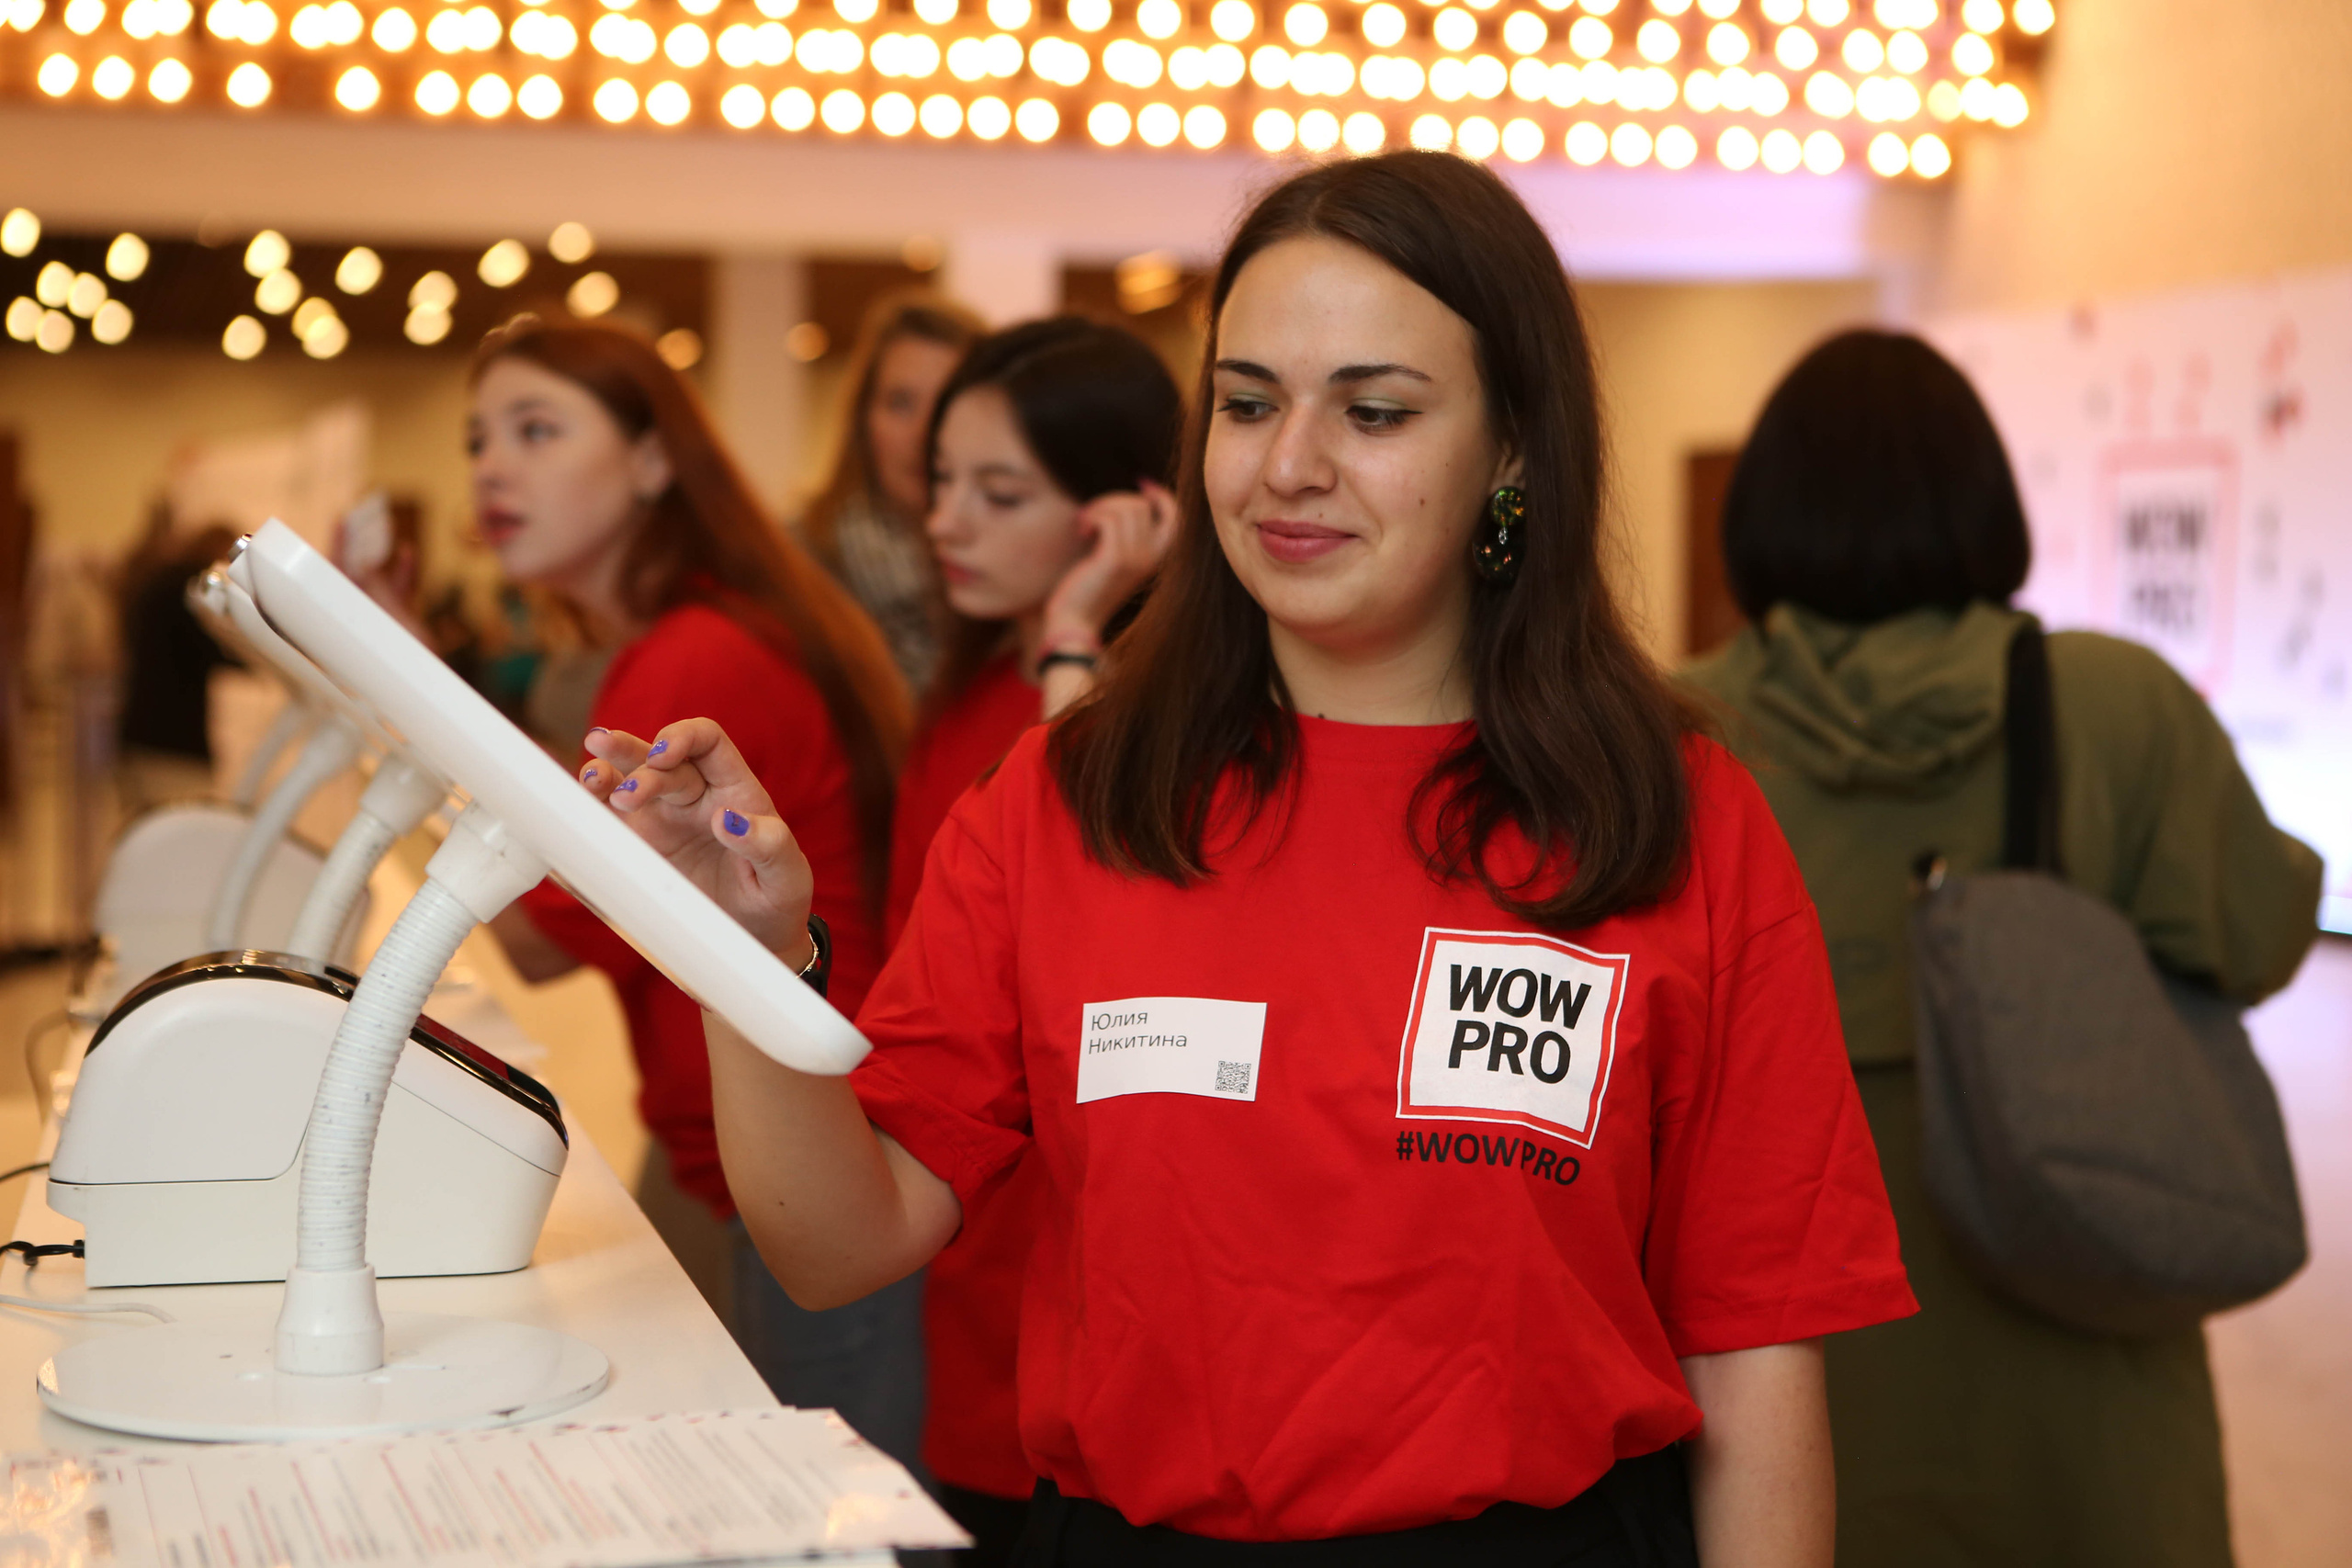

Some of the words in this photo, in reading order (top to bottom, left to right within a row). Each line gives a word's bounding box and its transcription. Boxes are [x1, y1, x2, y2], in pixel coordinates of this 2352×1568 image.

[1091, 1011, 1148, 1032] Юлия
[1449, 964, 1592, 1030] WOW
[1088, 1034, 1188, 1055] Никитина
[1448, 1020, 1571, 1084] PRO
[1396, 1130, 1581, 1186] #WOWPRO
